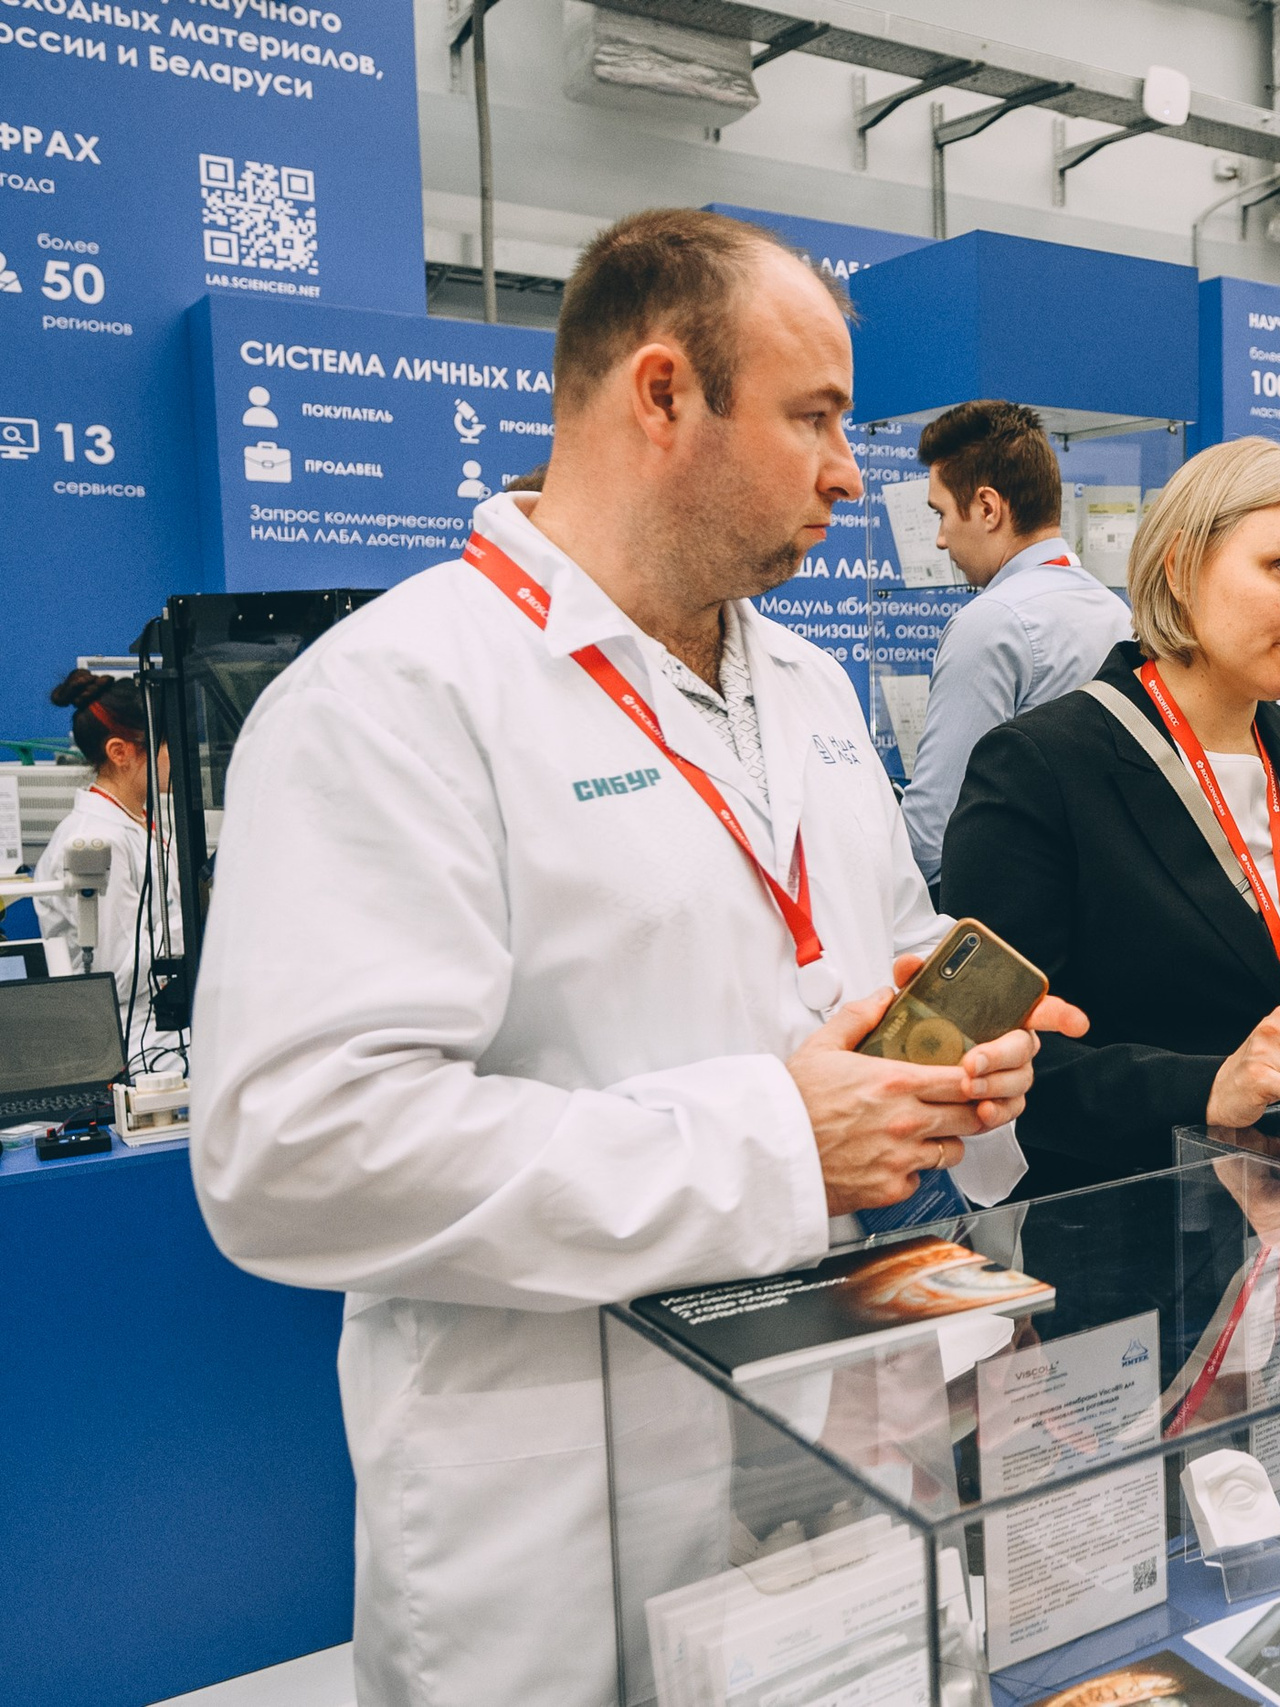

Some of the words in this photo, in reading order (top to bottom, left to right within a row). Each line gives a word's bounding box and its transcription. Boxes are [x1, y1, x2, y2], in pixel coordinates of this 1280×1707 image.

[170, 17, 384, 81] материалов,
[117, 45, 139, 68] и
[149, 45, 314, 99] Беларуси
[37, 233, 99, 255] более
[41, 260, 105, 305] 50
[205, 273, 321, 298] LAB.SCIENCEID.NET
[42, 315, 133, 336] регионов
[240, 340, 385, 378] СИСТЕМА
[393, 357, 509, 390] ЛИЧНЫХ
[516, 369, 556, 395] КА
[302, 403, 394, 424] ПОКУПАТЕЛЬ
[54, 422, 116, 465] 13
[304, 460, 384, 478] ПРОДАВЕЦ
[53, 480, 146, 498] сервисов
[250, 504, 320, 527] Запрос
[324, 510, 463, 531] коммерческого
[250, 525, 311, 543] НАША
[314, 528, 363, 544] ЛАБА
[366, 532, 446, 550] доступен
[760, 596, 833, 618] Модуль
[572, 767, 662, 802] СИБУР
[1200, 768, 1226, 817] ROSCONGRESS
[1246, 861, 1271, 911] РОСКОНГРЕСС
